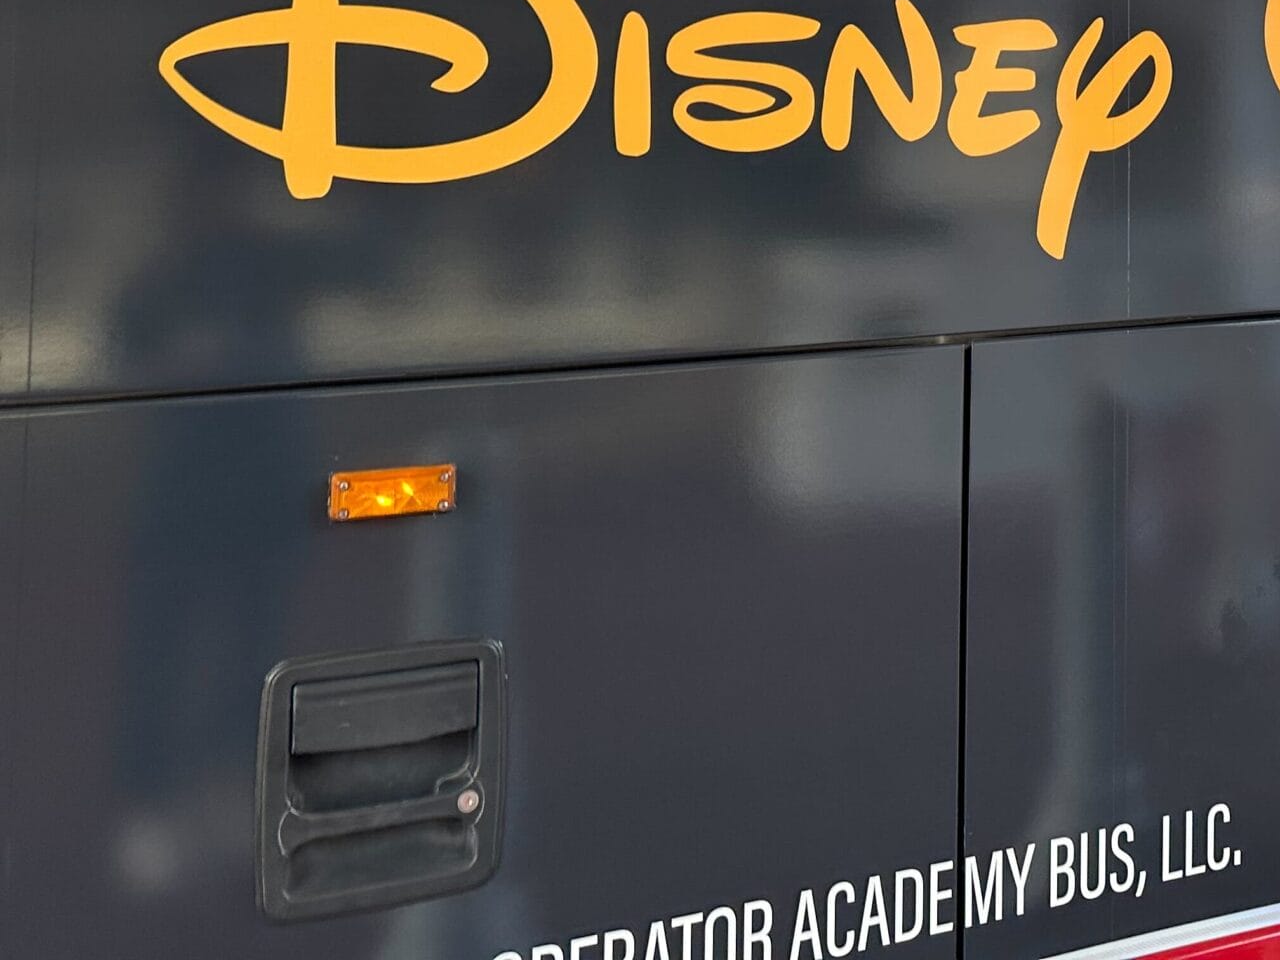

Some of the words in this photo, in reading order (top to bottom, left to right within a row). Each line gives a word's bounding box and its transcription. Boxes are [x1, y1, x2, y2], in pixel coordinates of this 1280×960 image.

[789, 842, 1036, 960] ACADEMY
[1049, 823, 1147, 908] BUS,
[1162, 803, 1243, 882] LLC.
